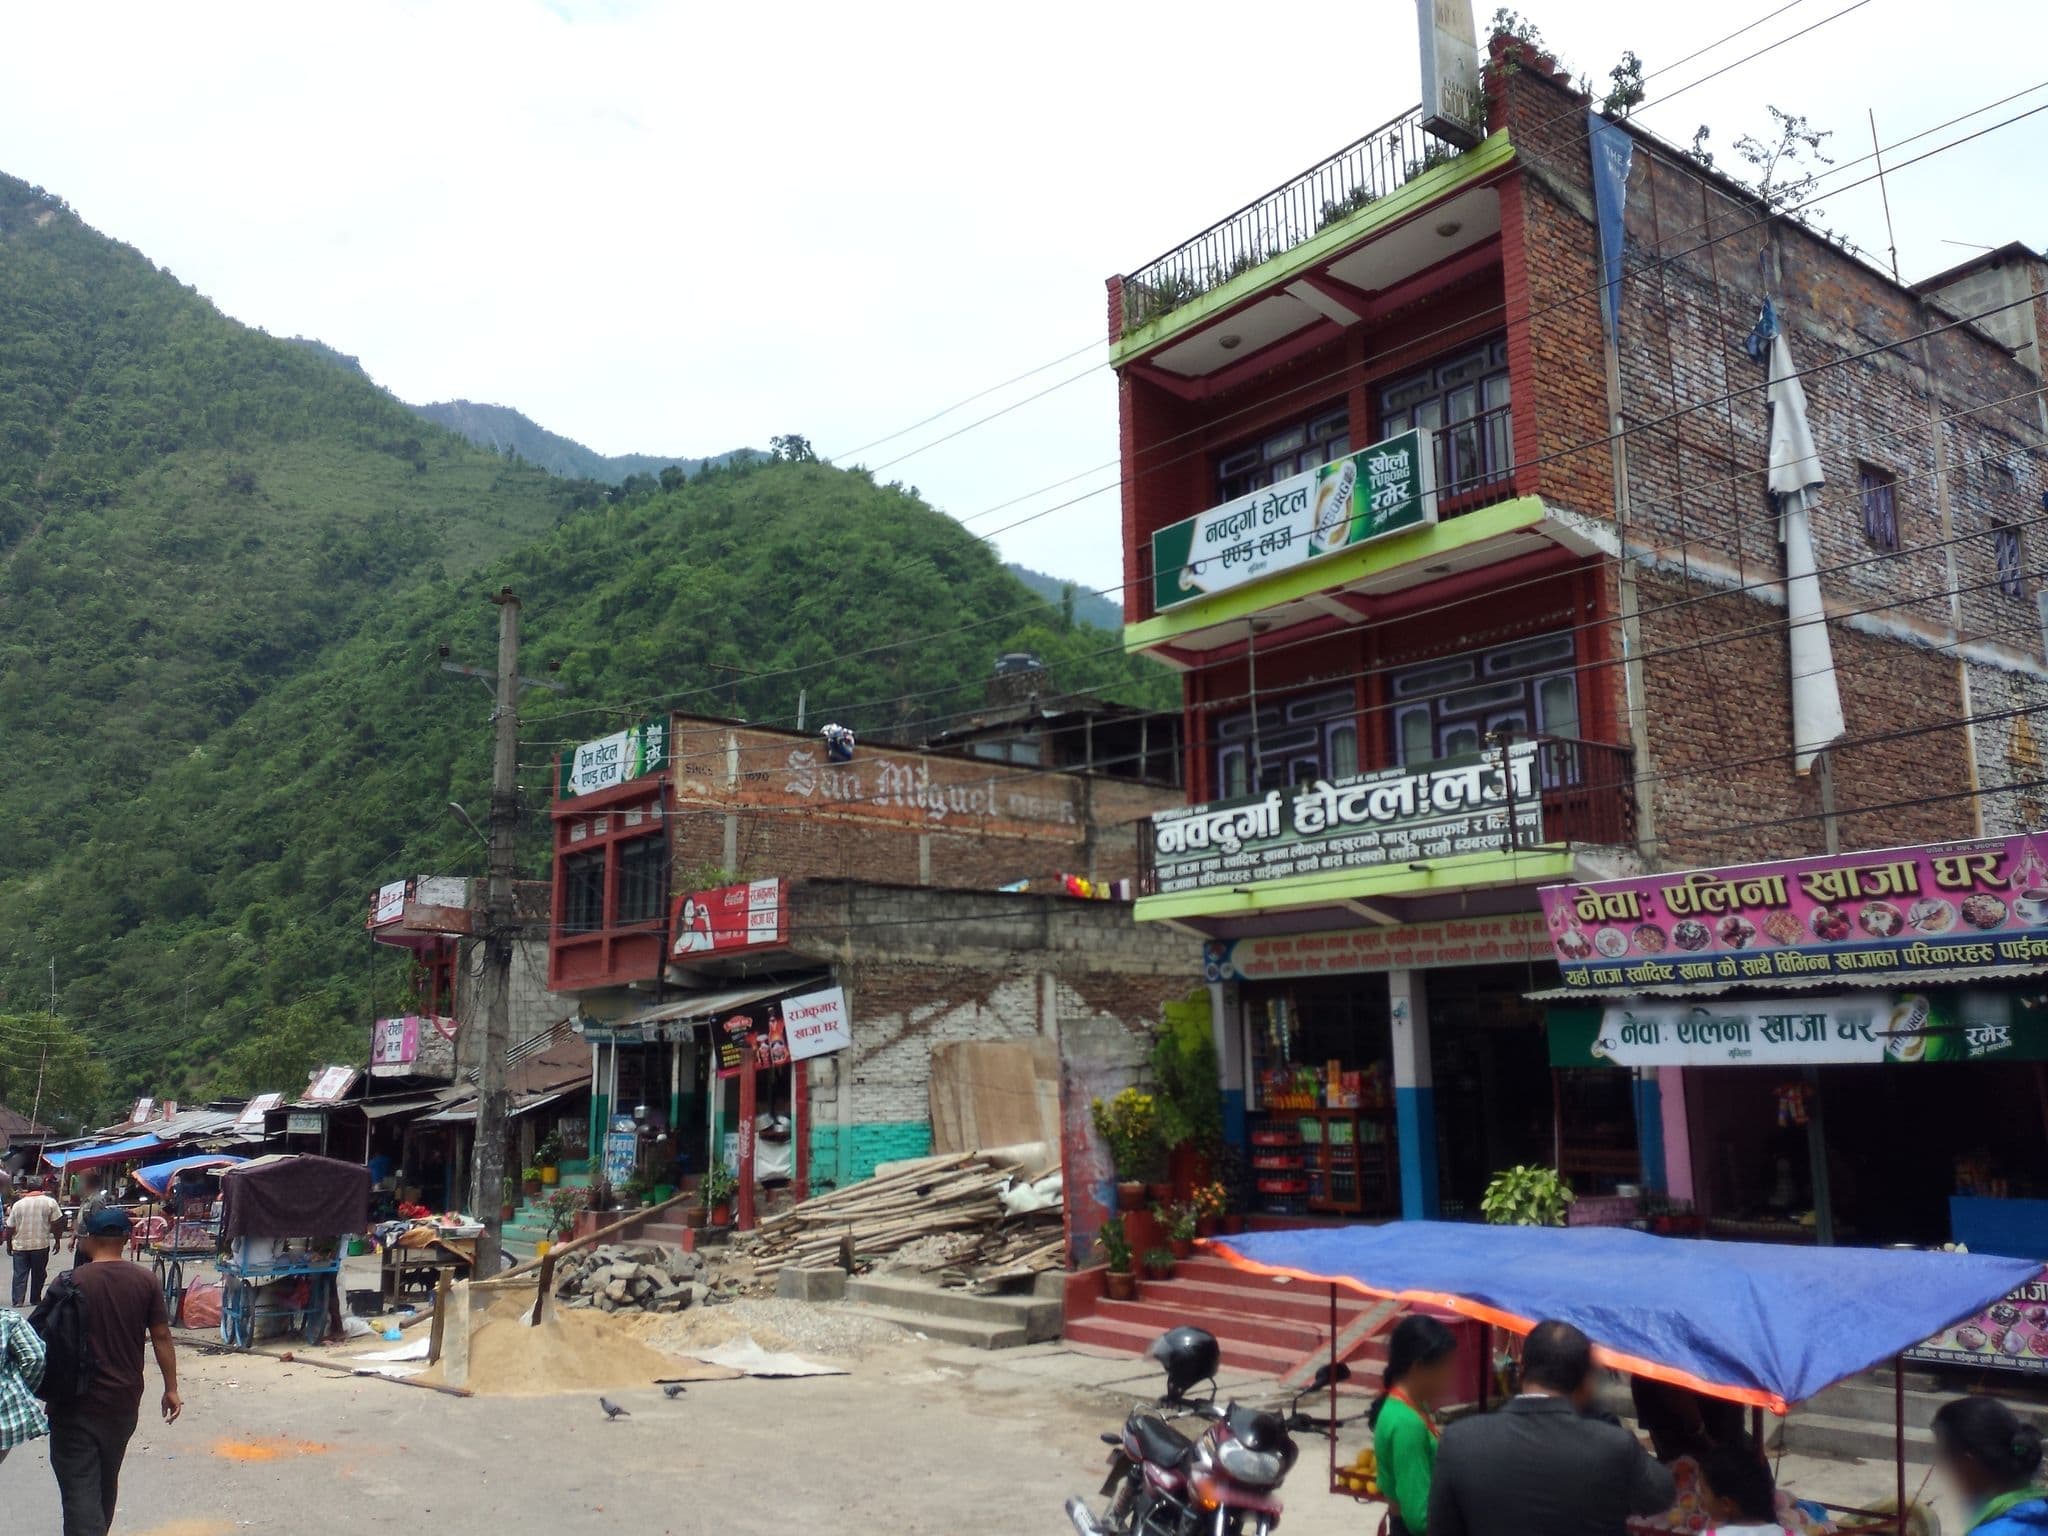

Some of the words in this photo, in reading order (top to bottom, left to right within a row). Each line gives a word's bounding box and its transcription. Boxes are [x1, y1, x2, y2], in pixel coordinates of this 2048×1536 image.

[1370, 466, 1410, 489] TUBORG
[1205, 505, 1258, 544] नवदुर्गा
[1262, 486, 1309, 523] होटल
[1221, 539, 1253, 570] एण्ड
[1259, 525, 1292, 557] लज
[596, 744, 618, 766] होटल
[601, 763, 617, 781] लज
[785, 750, 864, 801] San
[872, 759, 998, 820] Miguel
[1153, 790, 1283, 854] नवदुर्गा
[1292, 781, 1418, 834] होटल
[1430, 755, 1537, 812] लज
[1473, 821, 1483, 833] र
[1662, 875, 1788, 918] एलिना
[1800, 859, 1919, 904] खाजा
[1932, 851, 2007, 887] घर
[1565, 966, 1590, 986] यहाँ
[1592, 967, 1623, 984] ताजा
[1625, 961, 1676, 983] स्वादिष्ट
[1677, 962, 1714, 980] खाना
[1717, 956, 1738, 977] को
[1741, 953, 1773, 977] साथै
[1774, 951, 1831, 974] विभिन्न
[1833, 949, 1899, 970] खाजाका
[788, 1001, 839, 1022] राजकुमार
[1677, 1008, 1750, 1044] एलिना
[1759, 1014, 1827, 1044] खाजा
[793, 1023, 821, 1041] खाजा
[824, 1020, 840, 1033] घर
